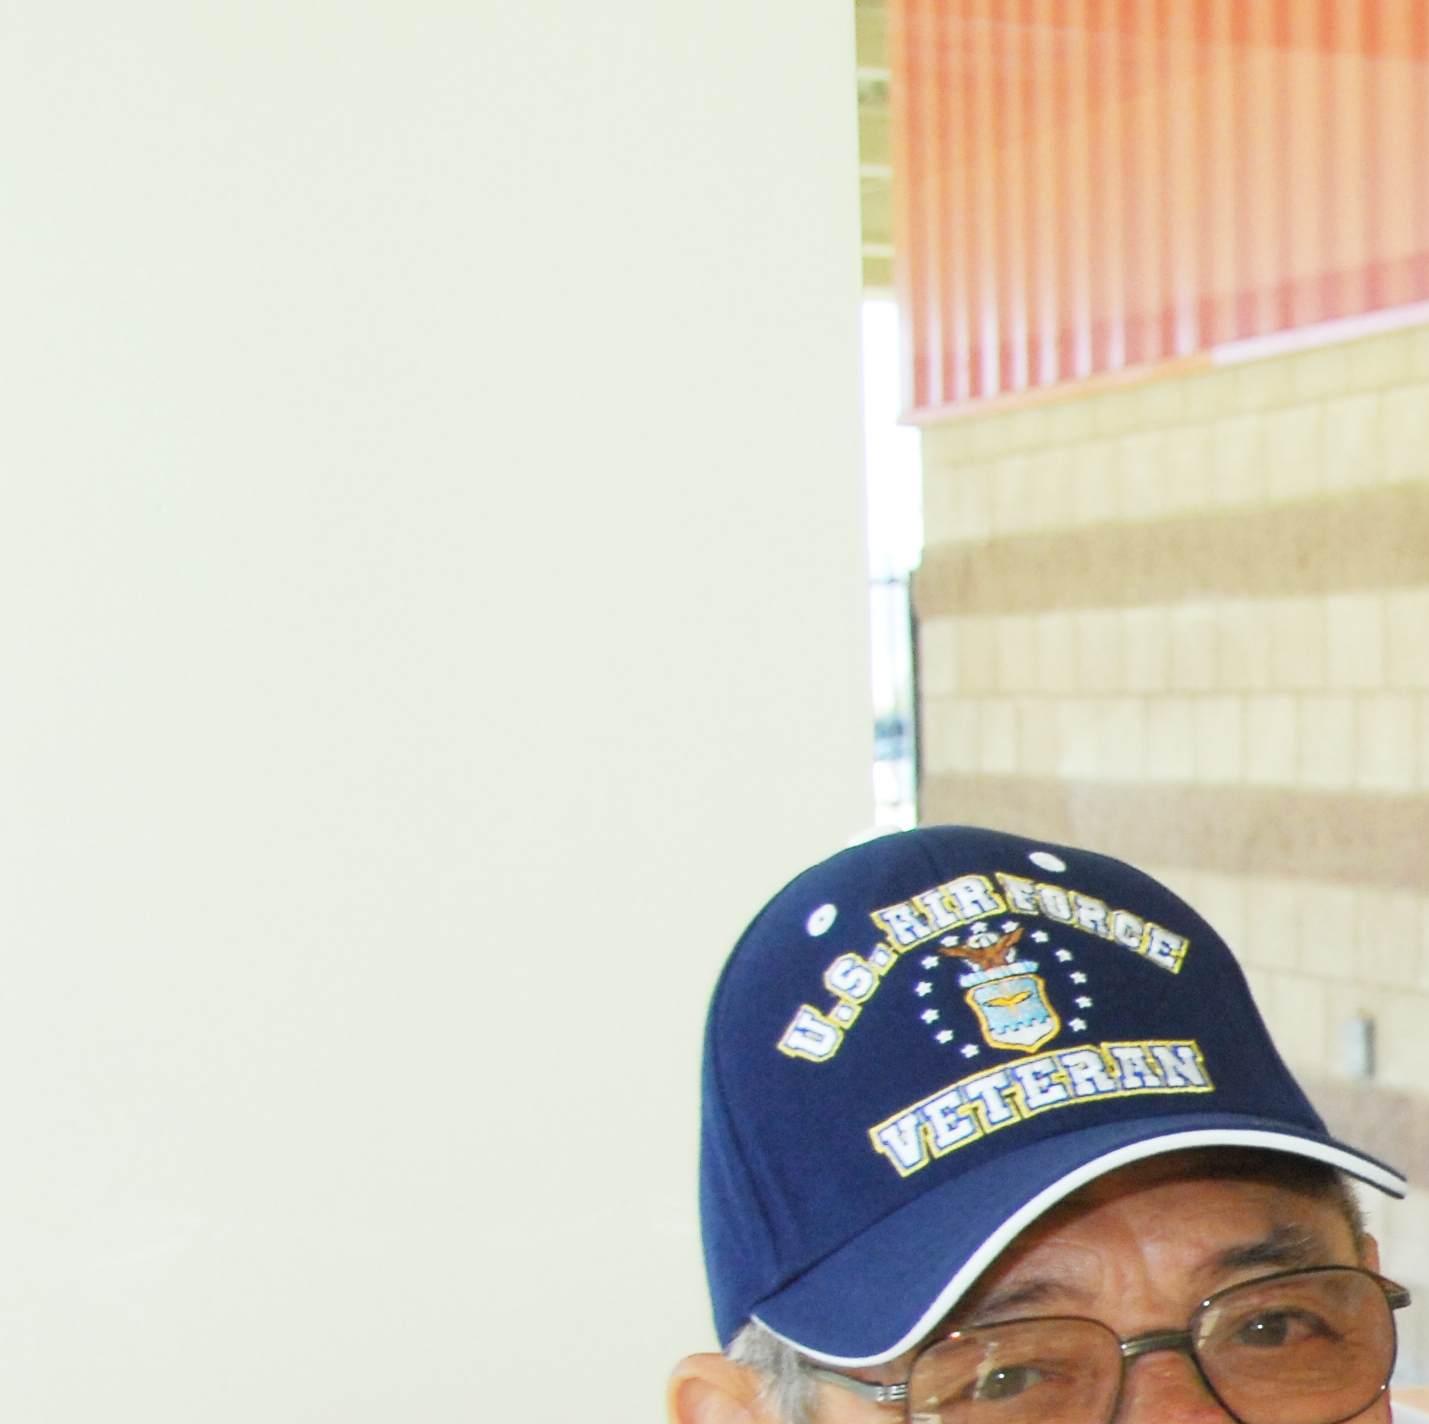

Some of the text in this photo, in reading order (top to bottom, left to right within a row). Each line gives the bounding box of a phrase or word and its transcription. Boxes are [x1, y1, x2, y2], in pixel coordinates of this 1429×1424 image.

[776, 872, 1190, 1063] U.S. AIR FORCE
[868, 1039, 1213, 1178] VETERAN
